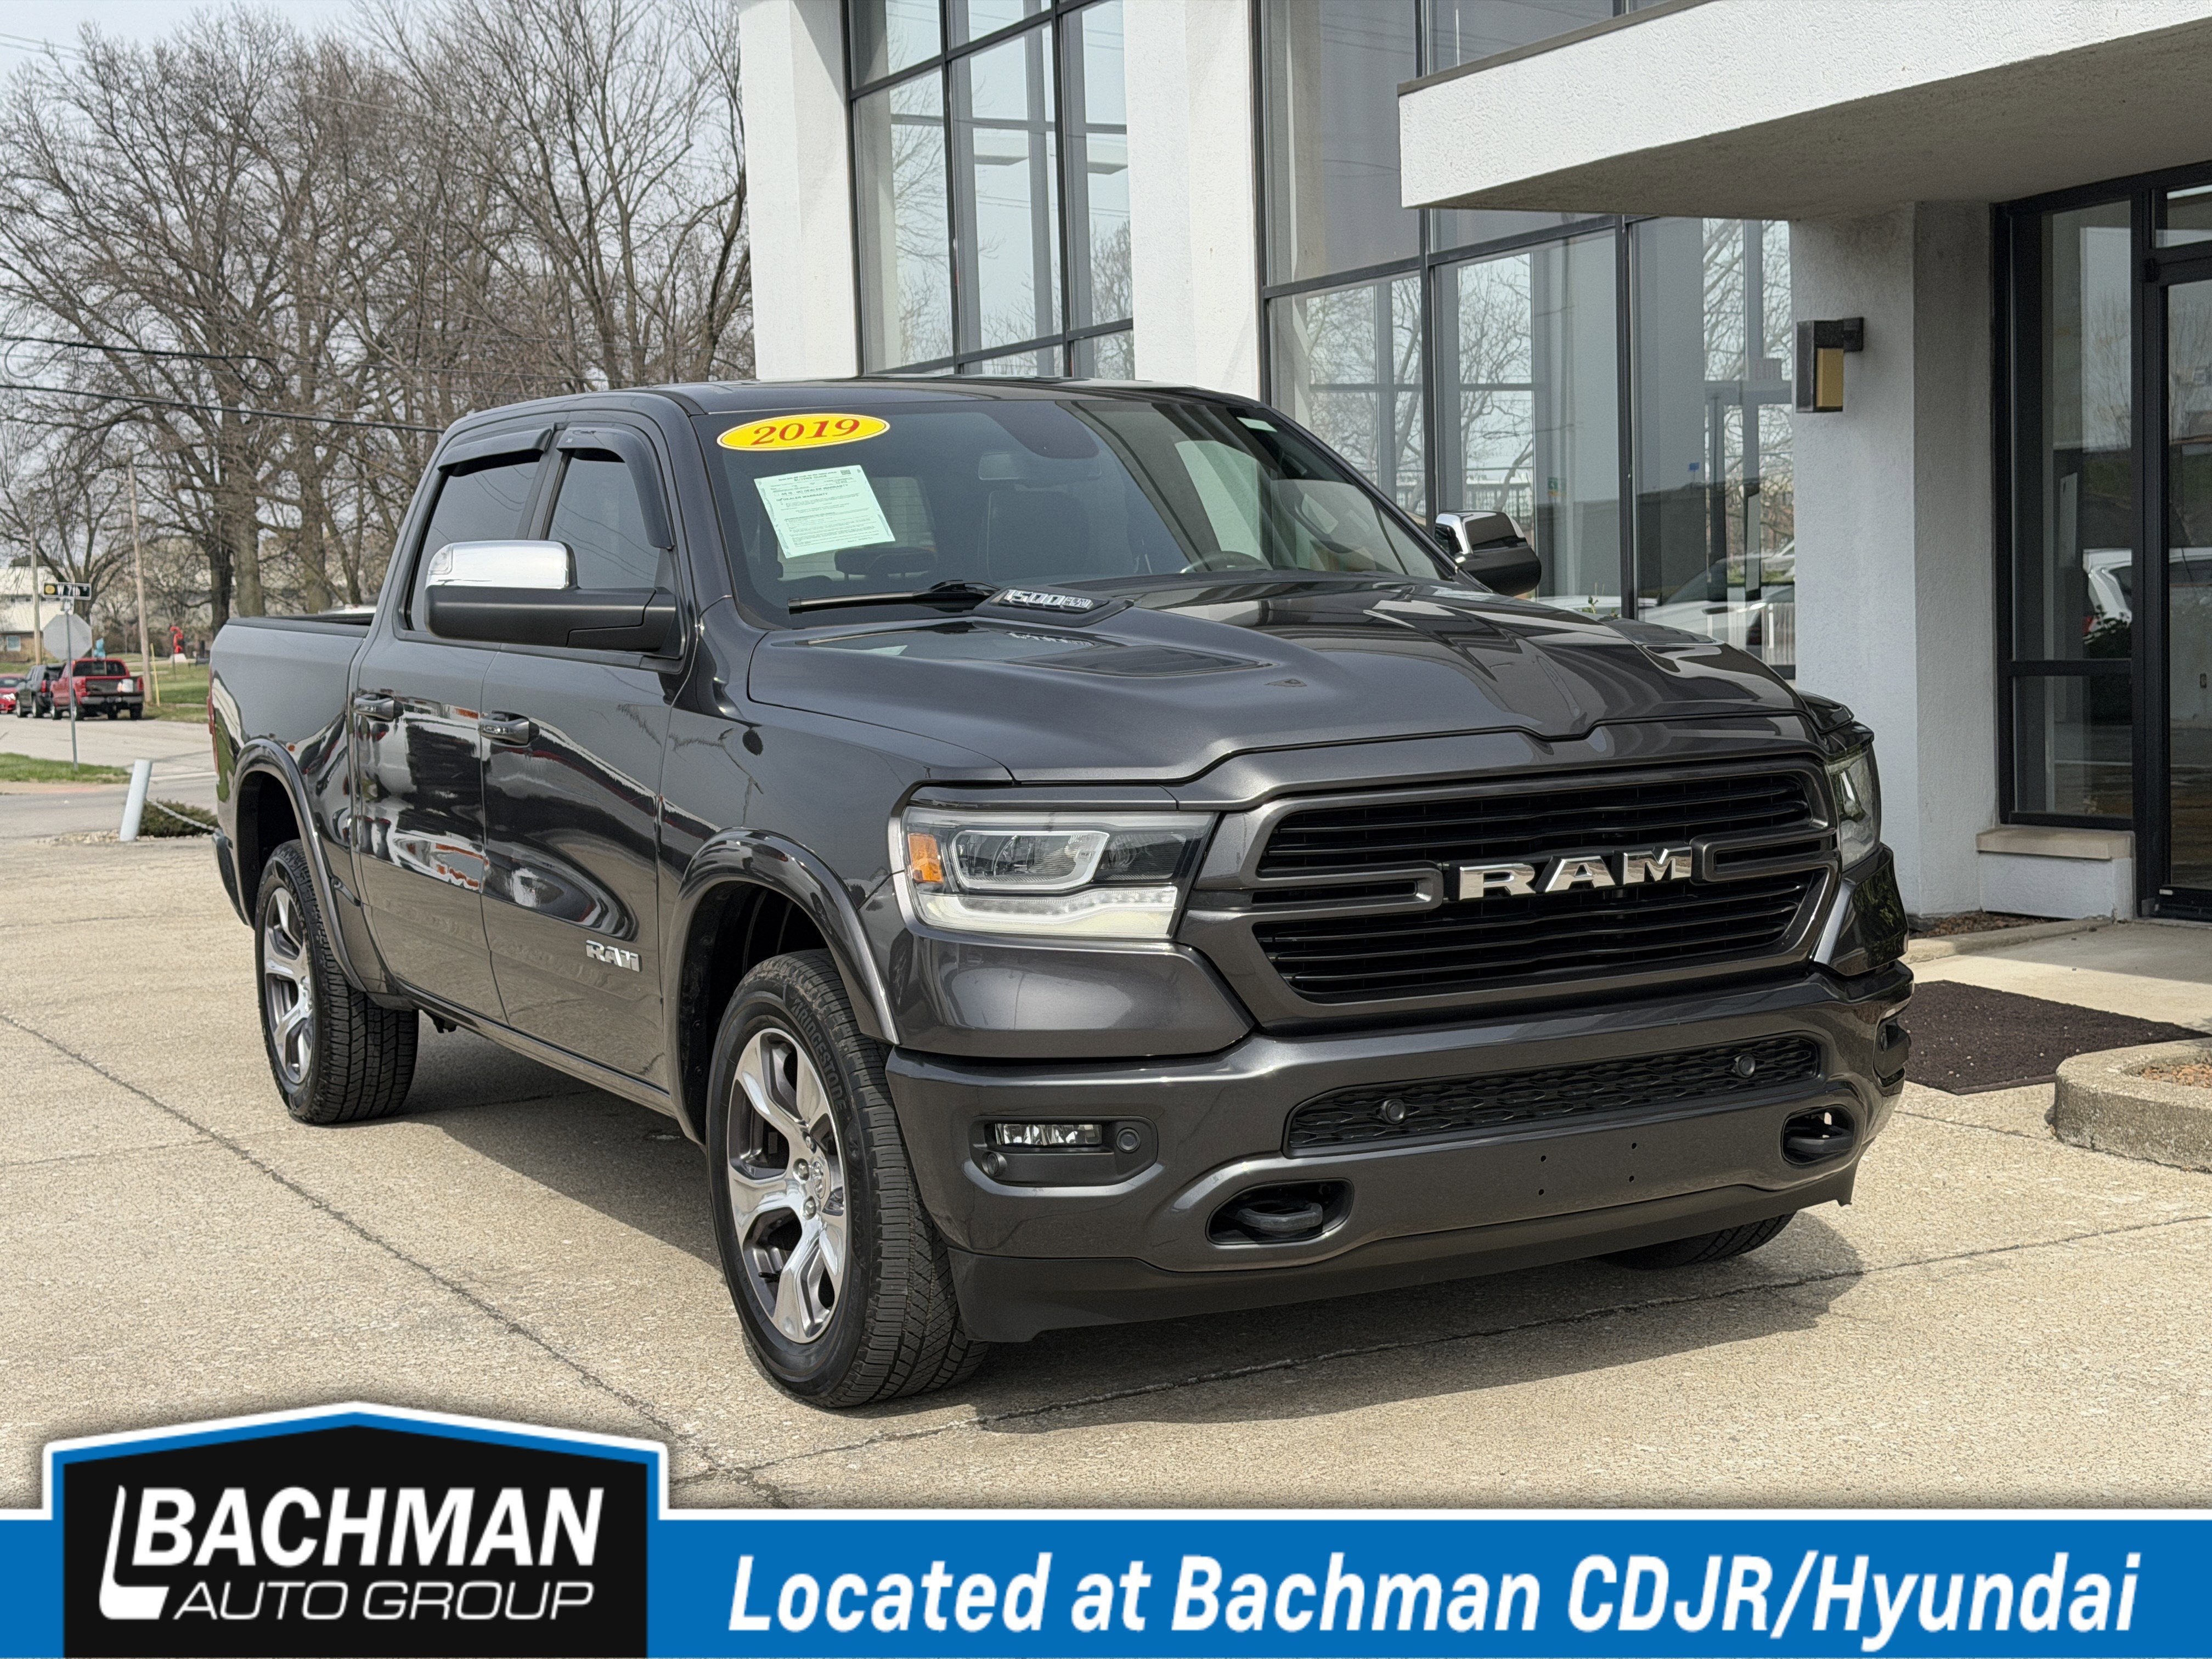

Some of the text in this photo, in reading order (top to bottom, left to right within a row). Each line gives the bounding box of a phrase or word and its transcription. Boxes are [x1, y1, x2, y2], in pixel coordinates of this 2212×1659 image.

[751, 419, 860, 445] 2019
[1004, 589, 1066, 606] 1500
[1459, 846, 1692, 901] RAM
[585, 939, 642, 972] RAM
[790, 996, 847, 1112] BRIDGESTONE
